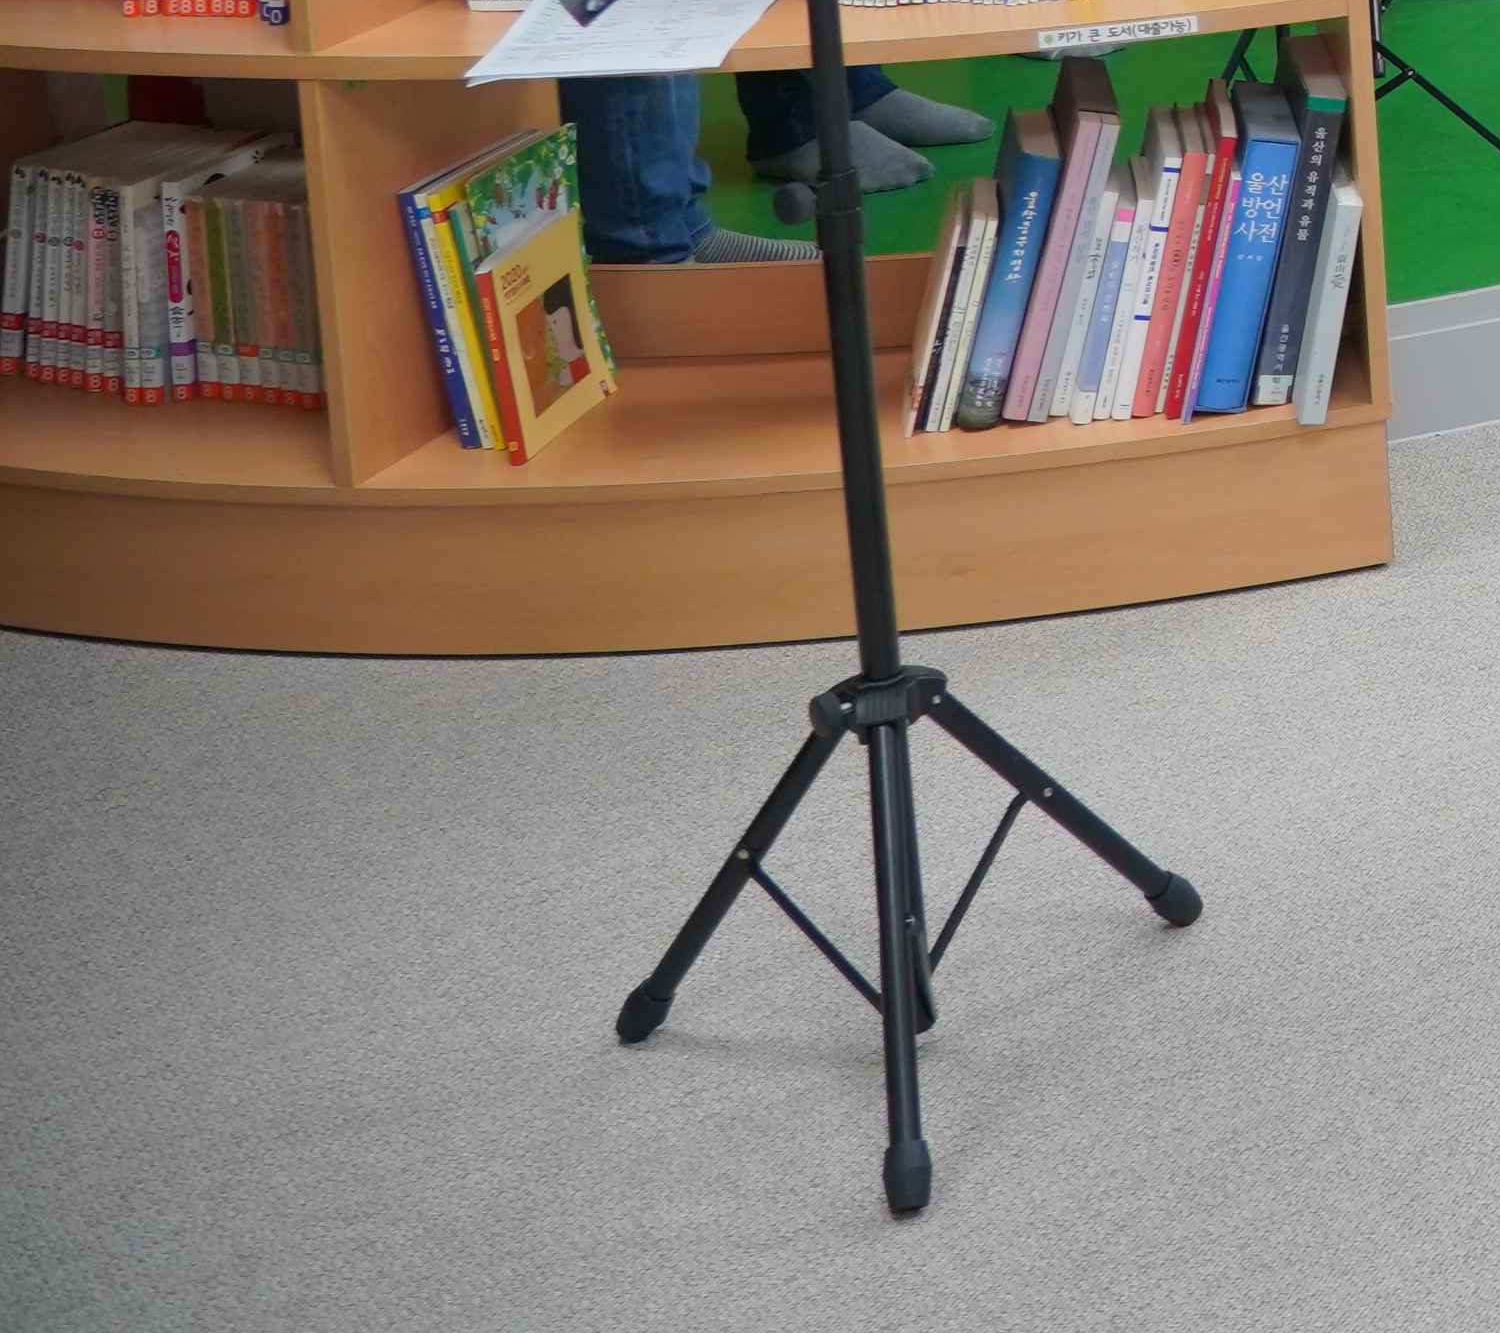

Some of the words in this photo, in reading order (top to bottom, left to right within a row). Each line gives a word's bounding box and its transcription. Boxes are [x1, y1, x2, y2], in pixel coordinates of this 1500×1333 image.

[1057, 31, 1083, 43] 키가
[1088, 29, 1101, 43] 큰
[1106, 17, 1192, 39] 도서(대출가능)
[1309, 126, 1328, 167] 울산의
[1243, 171, 1290, 196] 울산
[1300, 170, 1320, 212] 유적과
[1240, 196, 1283, 219] 방언
[1233, 219, 1279, 244] 사전
[1296, 215, 1313, 241] 유물
